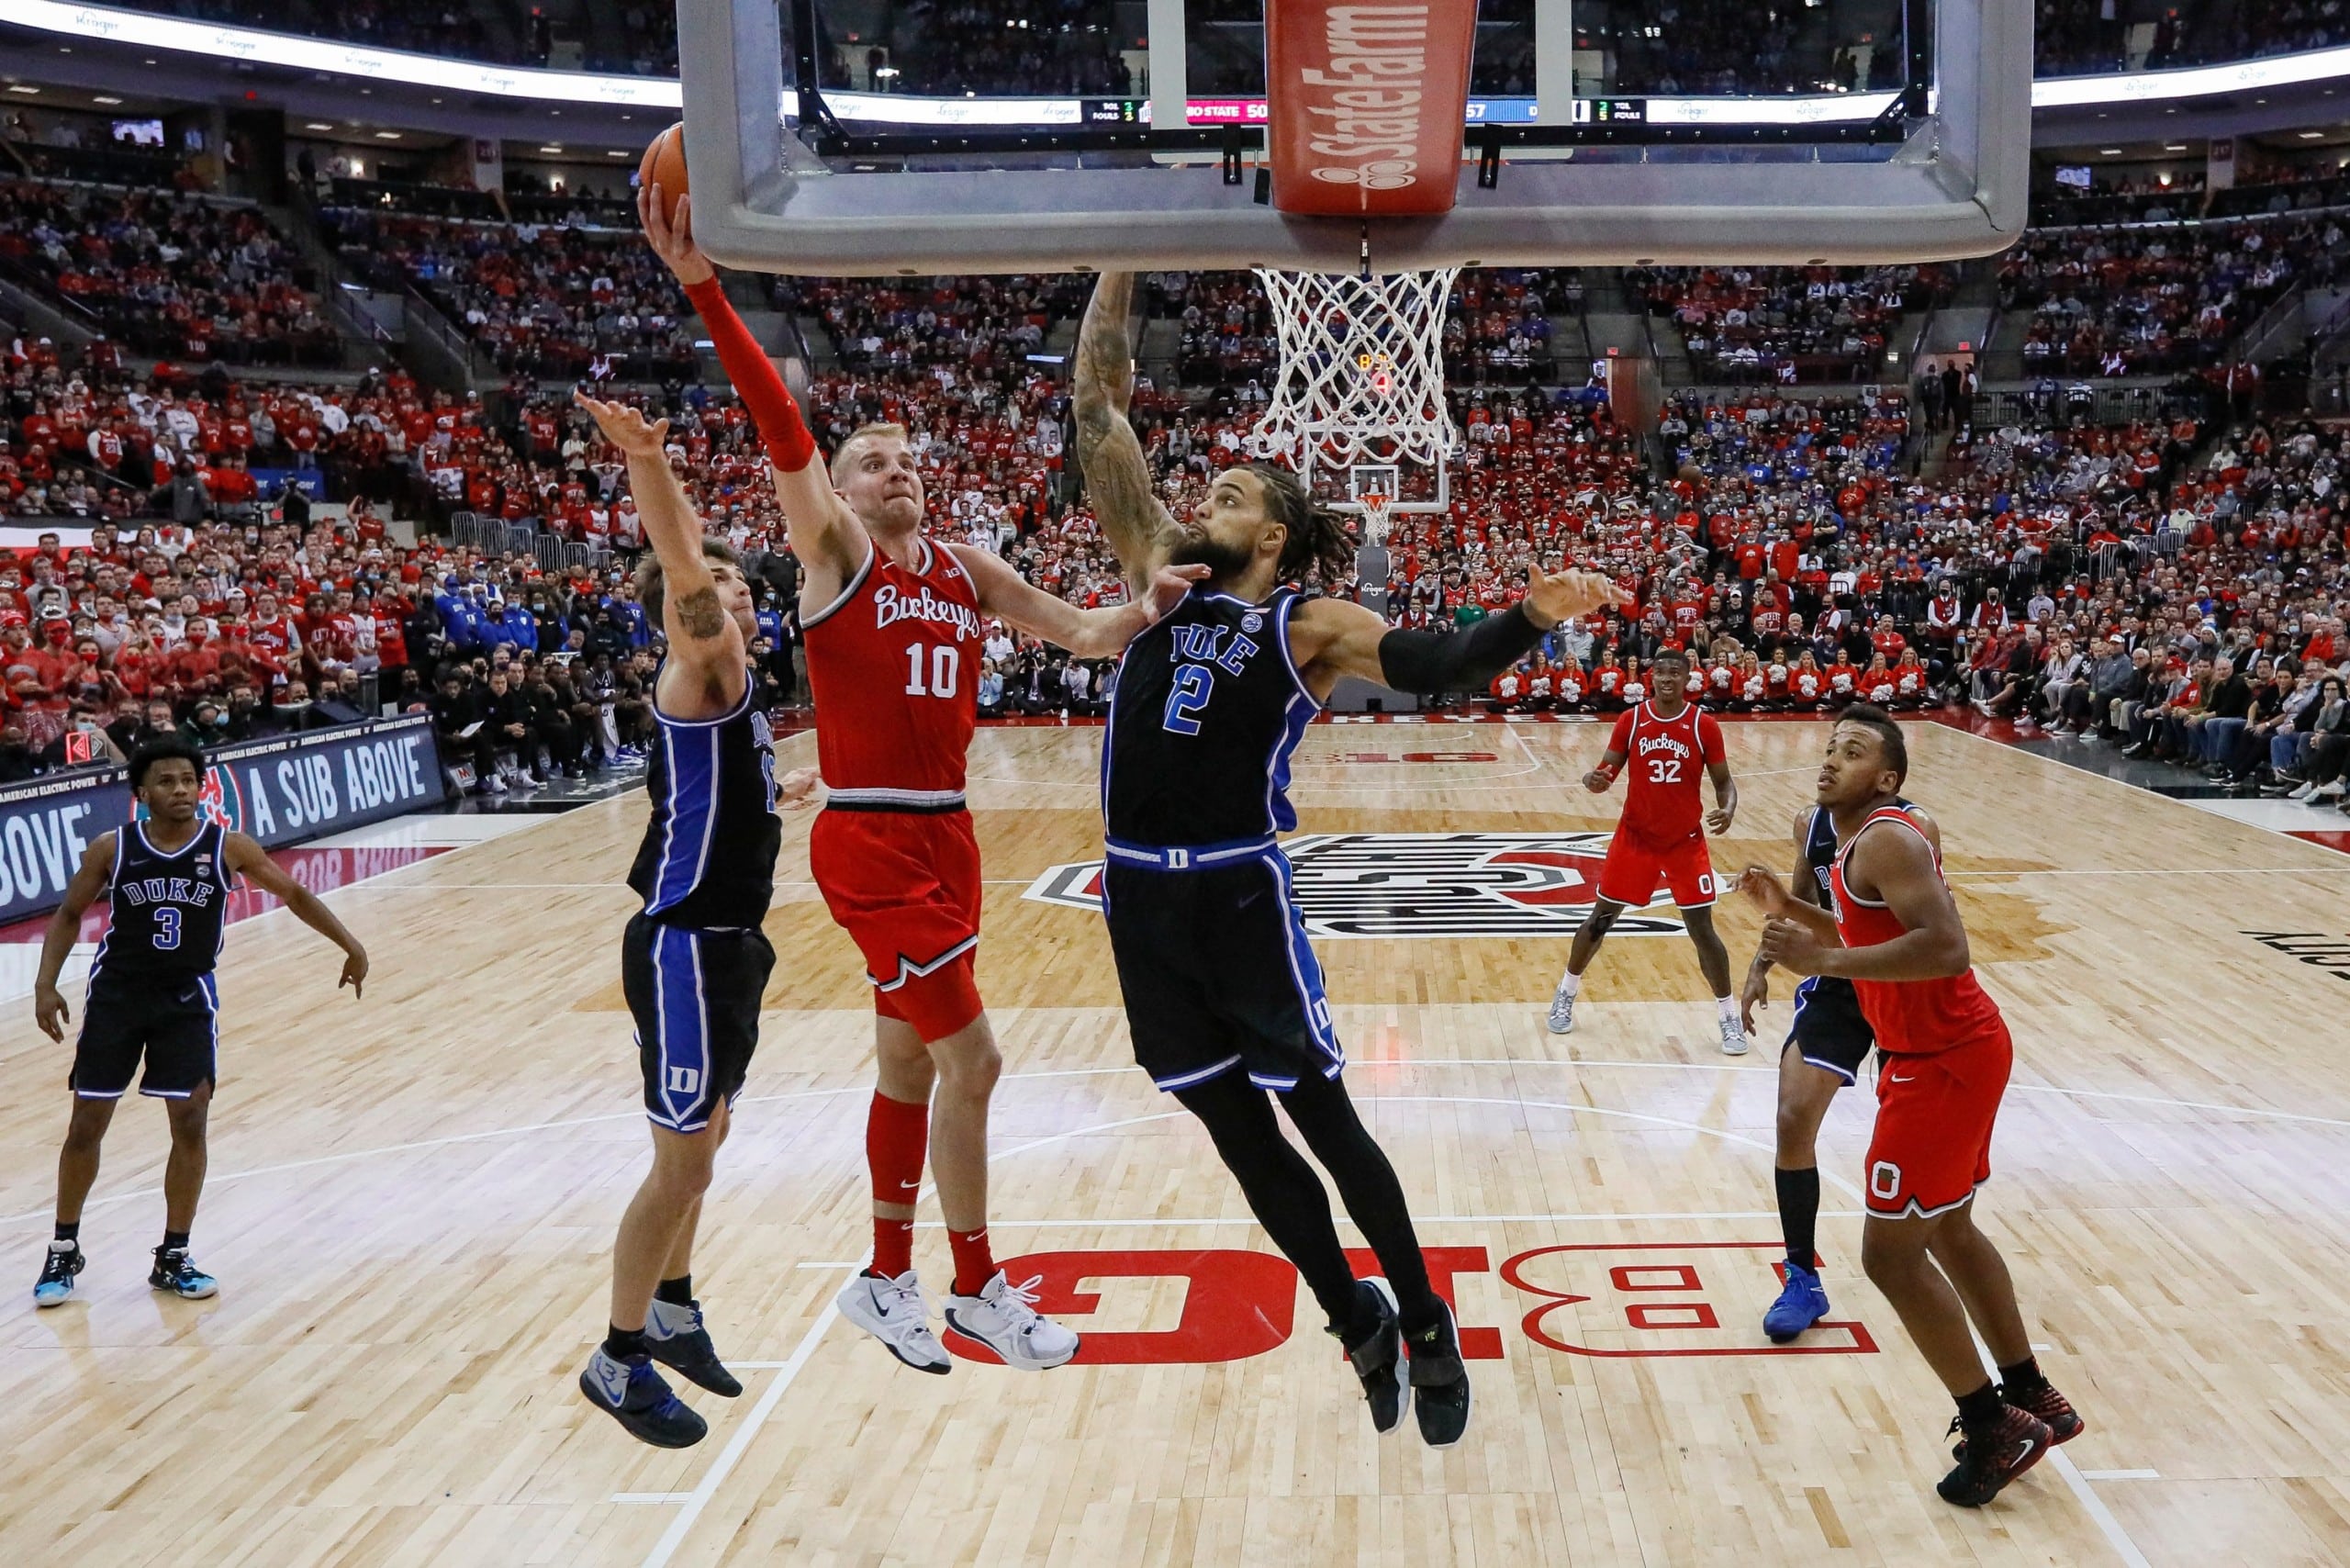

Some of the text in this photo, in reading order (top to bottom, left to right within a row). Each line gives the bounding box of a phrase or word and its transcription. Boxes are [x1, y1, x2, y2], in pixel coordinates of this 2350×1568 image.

[1204, 106, 1239, 117] STATE
[1248, 104, 1267, 118] 50
[1466, 104, 1485, 118] 57
[1360, 582, 1385, 597] Kroger
[874, 585, 979, 642] Buckeyes
[905, 643, 959, 698] 10
[345, 728, 362, 738] POWER
[268, 742, 287, 753] POWER
[1639, 733, 1689, 758] Buckeyes
[1648, 760, 1682, 783] 32
[0, 776, 96, 803] AMERICAN ELECTRIC POWER
[250, 767, 276, 837] A
[278, 755, 338, 827] SUB
[344, 737, 426, 812] ABOVE
[1168, 849, 1189, 868] D
[122, 878, 214, 907] DUKE
[153, 907, 182, 950] 3
[668, 1066, 699, 1093] D
